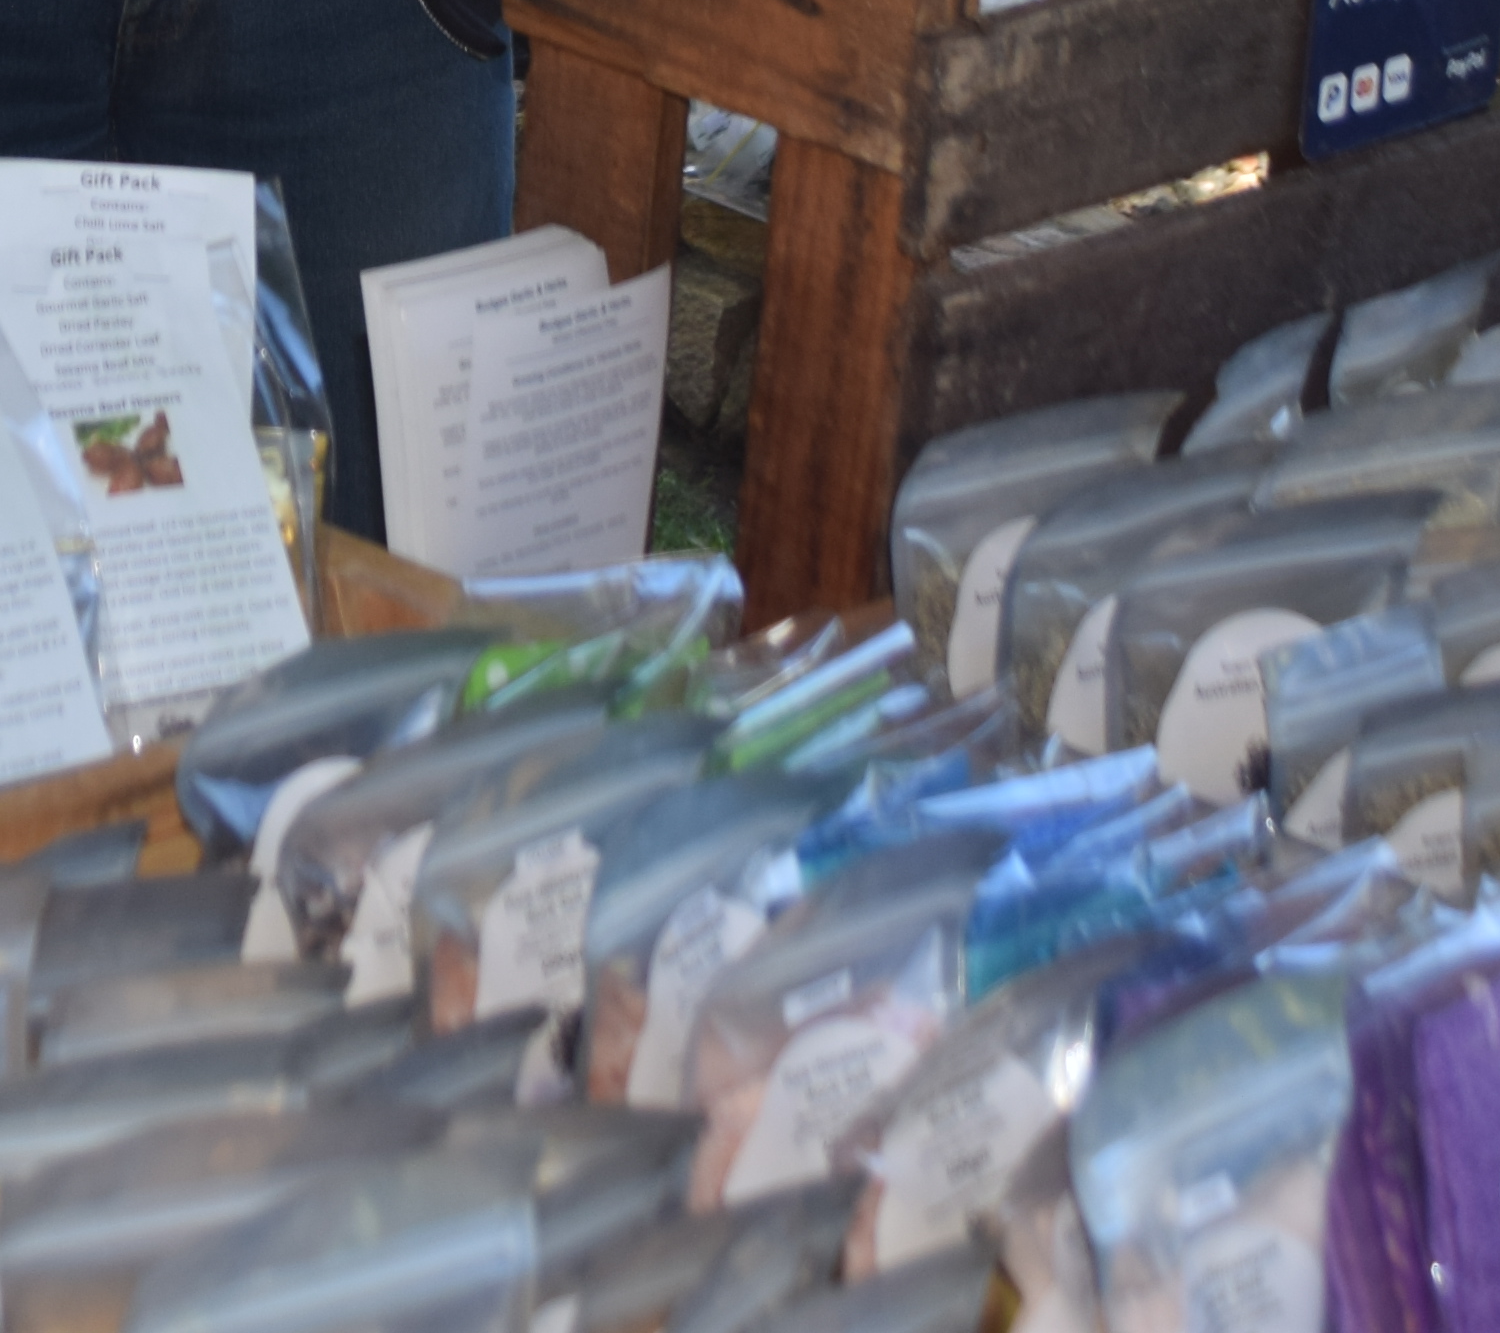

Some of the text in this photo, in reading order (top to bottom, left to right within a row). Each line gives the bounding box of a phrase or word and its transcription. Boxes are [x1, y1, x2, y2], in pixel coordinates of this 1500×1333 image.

[80, 170, 161, 191] Gift Pack
[50, 245, 124, 269] Gift Pack
